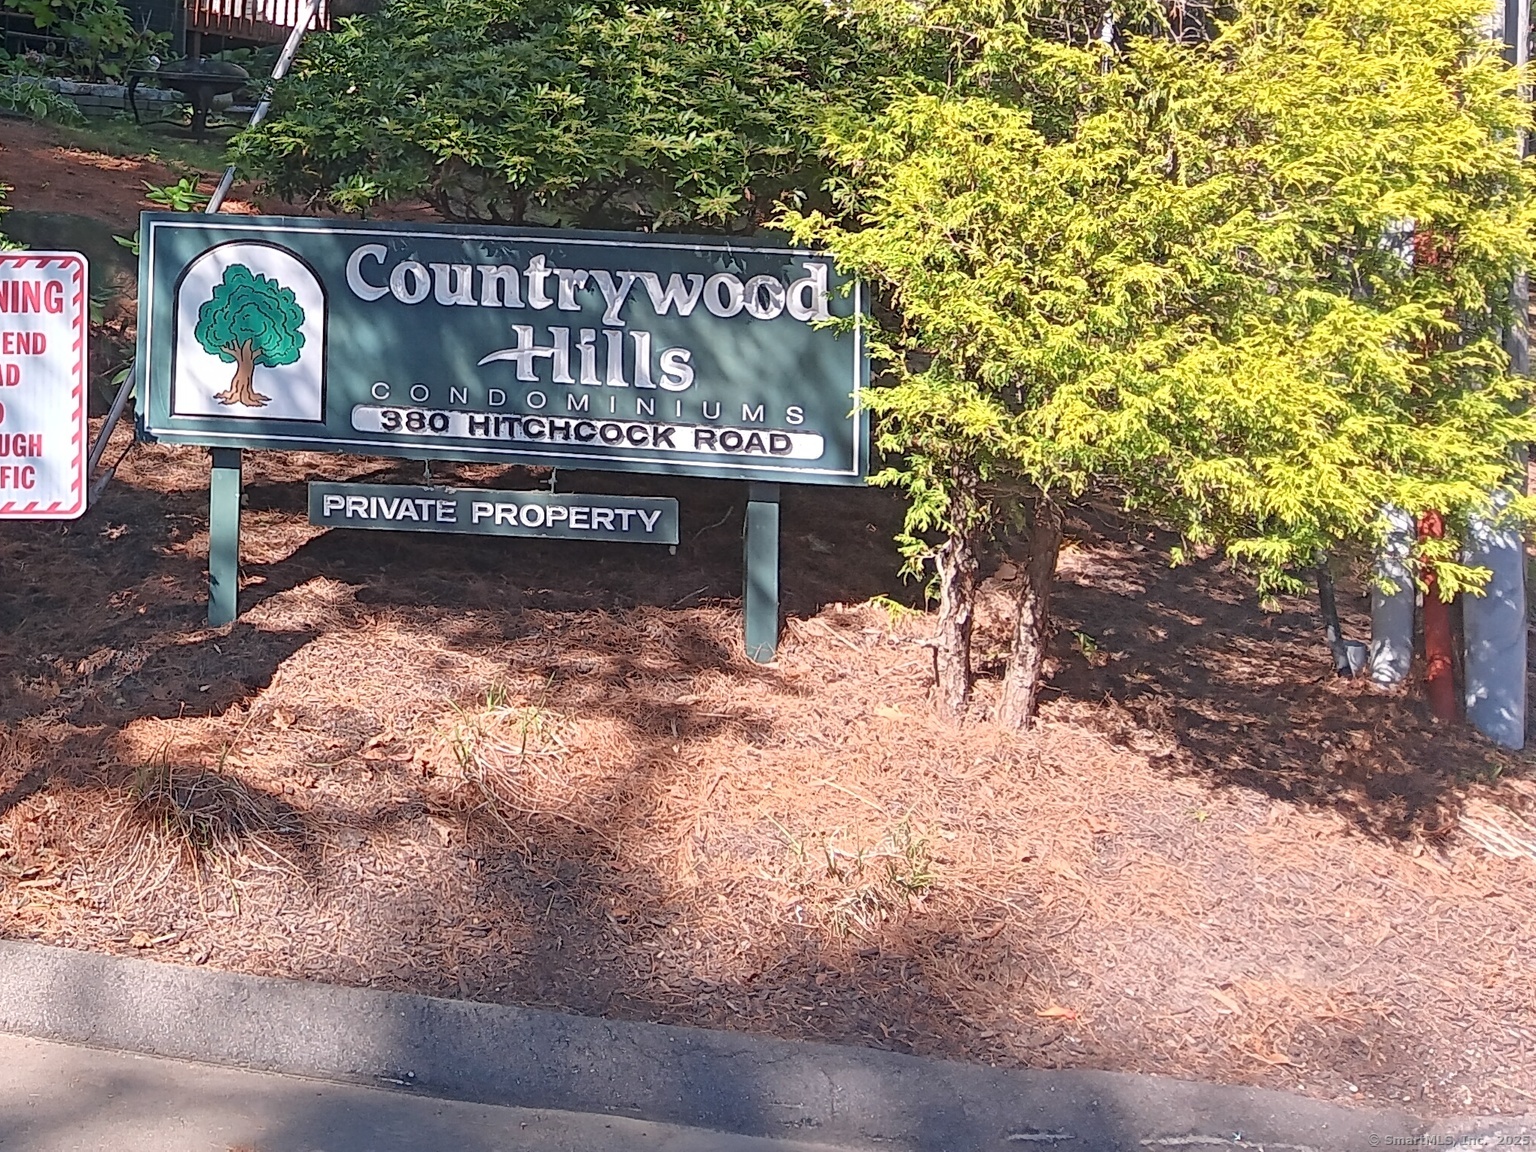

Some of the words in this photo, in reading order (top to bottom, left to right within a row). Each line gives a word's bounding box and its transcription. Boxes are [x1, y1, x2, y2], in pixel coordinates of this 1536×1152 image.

[345, 244, 831, 326] Countrywood
[2, 332, 47, 355] END
[477, 324, 695, 392] Hills
[370, 381, 805, 425] CONDOMINIUMS
[380, 409, 450, 433] 380
[467, 414, 677, 450] HITCHCOCK
[693, 428, 794, 456] ROAD
[322, 494, 458, 524] PRIVATE
[471, 500, 663, 534] PROPERTY
